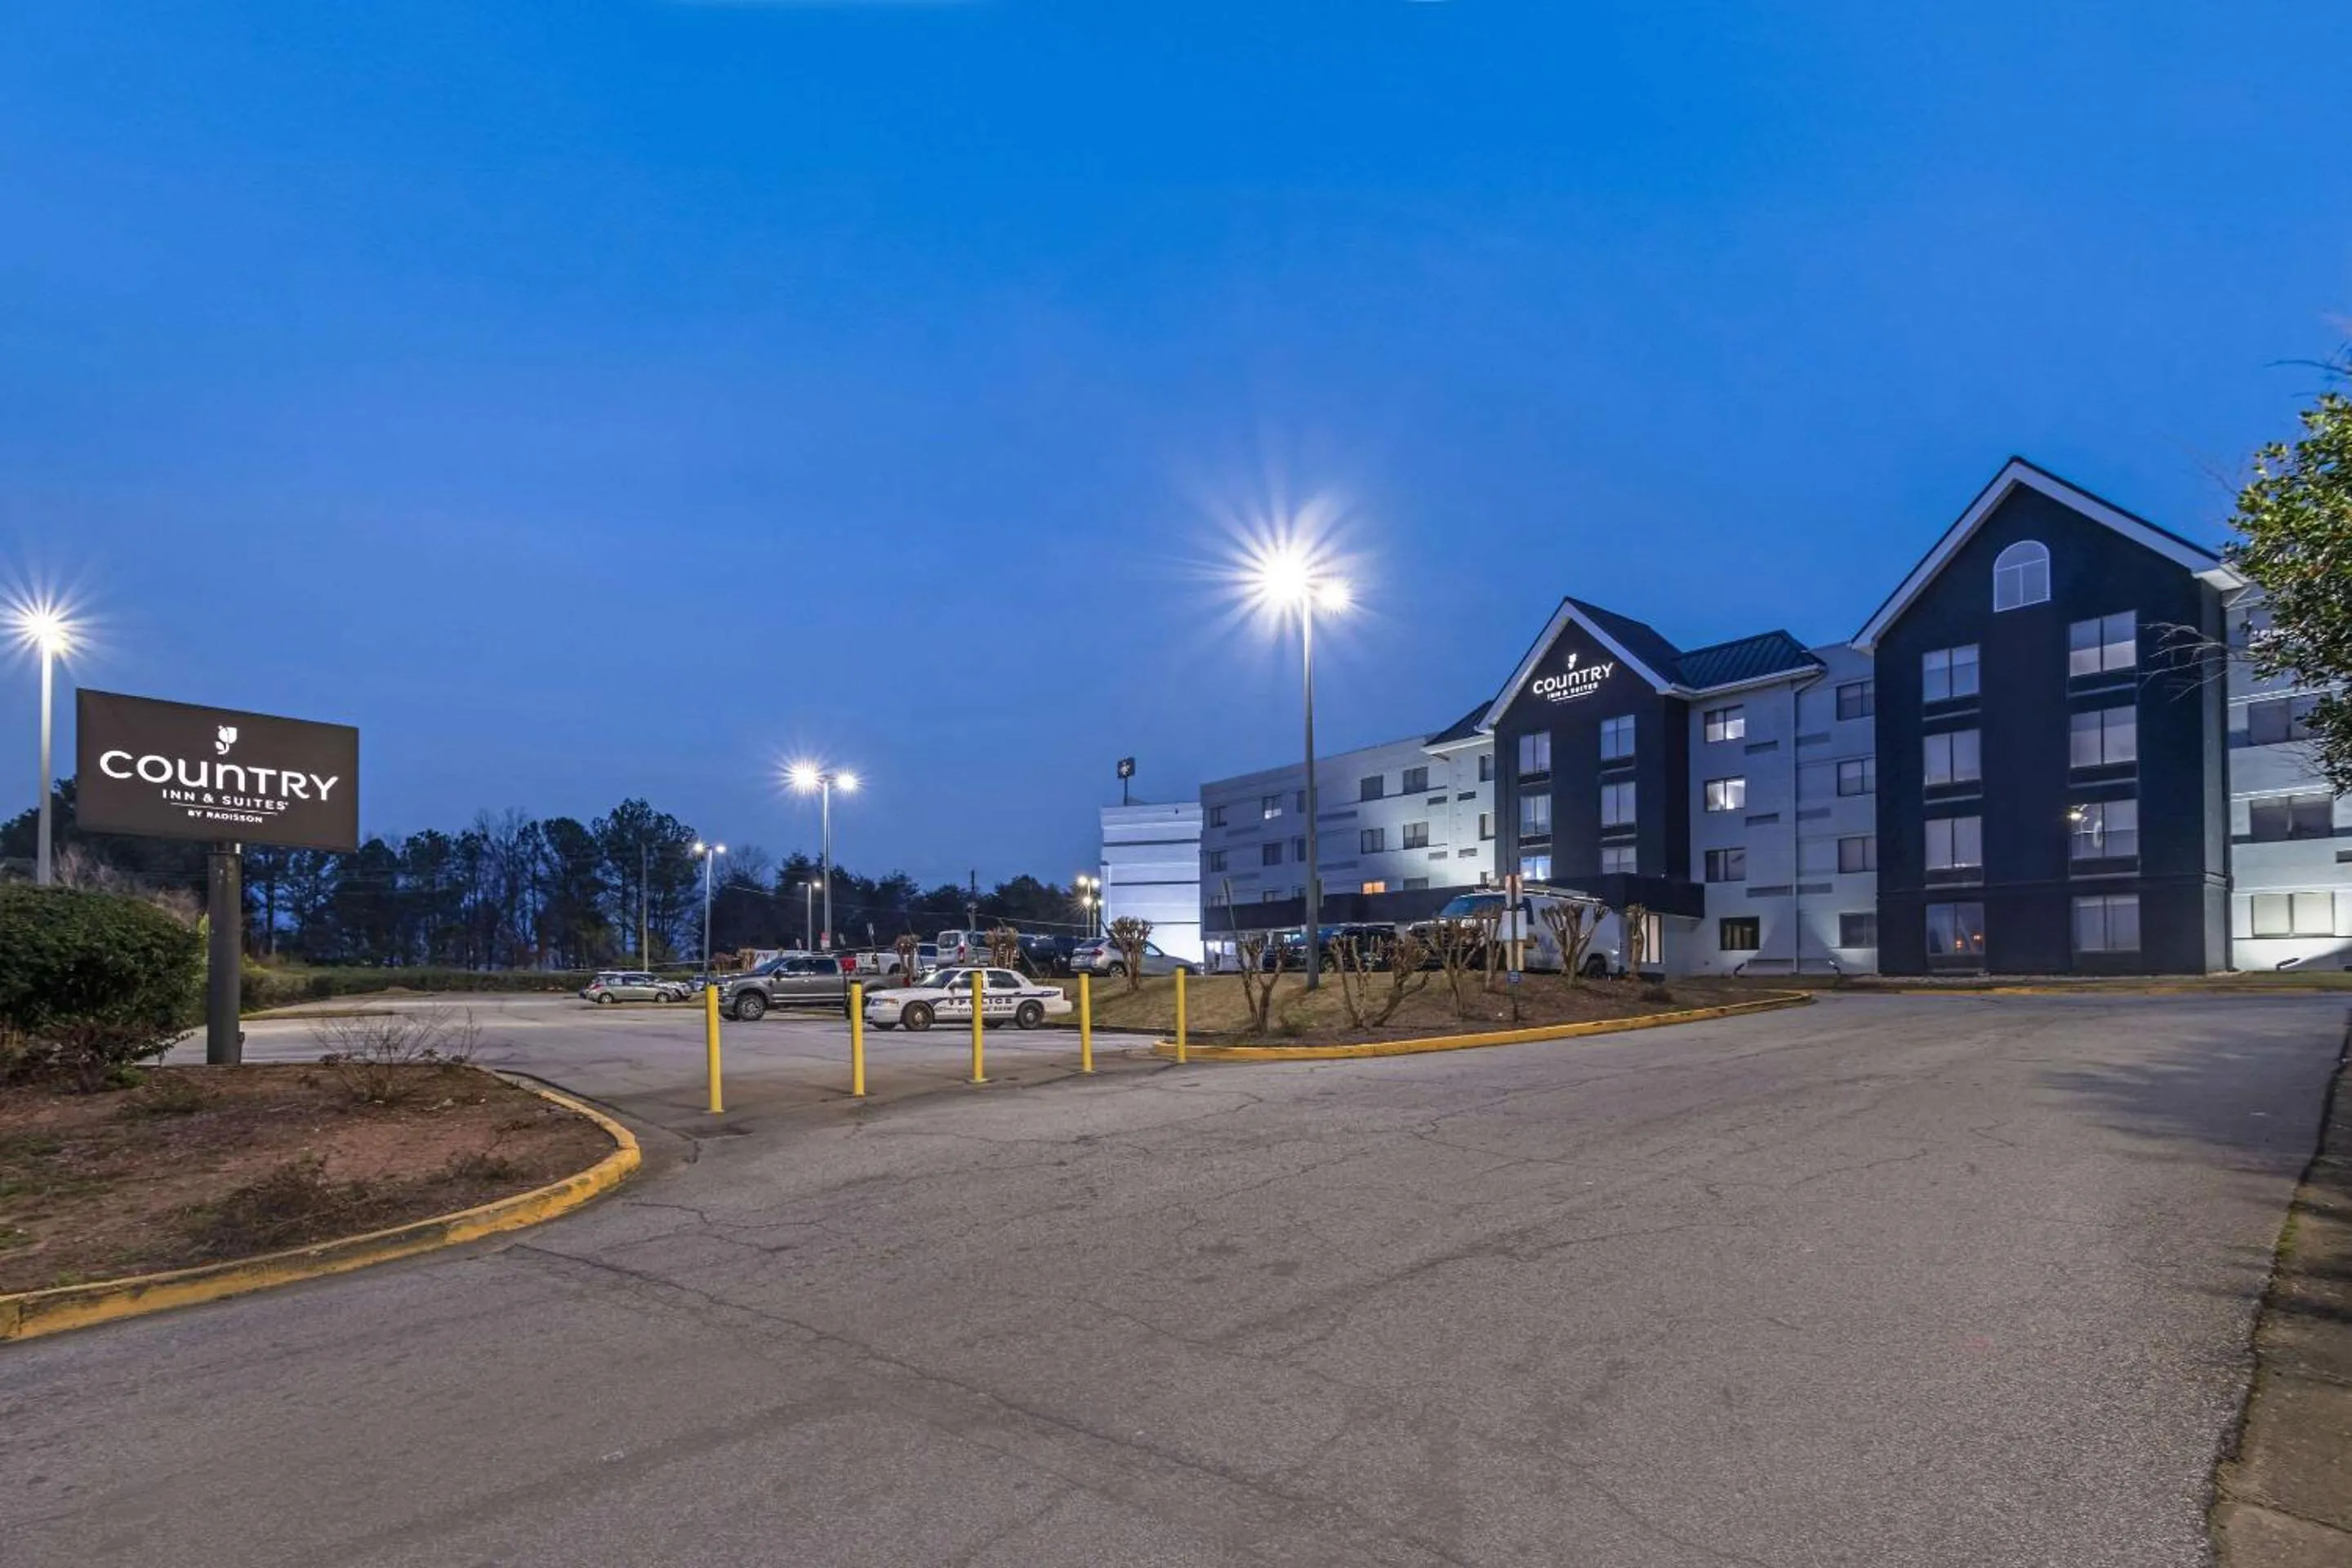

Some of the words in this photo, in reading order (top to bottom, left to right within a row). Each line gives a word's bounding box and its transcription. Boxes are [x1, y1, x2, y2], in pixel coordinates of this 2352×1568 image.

[1533, 662, 1614, 694] COUNTRY
[99, 750, 339, 801] COUNTRY
[163, 789, 195, 801] INN
[203, 793, 214, 804] &
[221, 795, 287, 811] SUITES
[187, 809, 203, 817] BY
[207, 812, 263, 824] RADISSON
